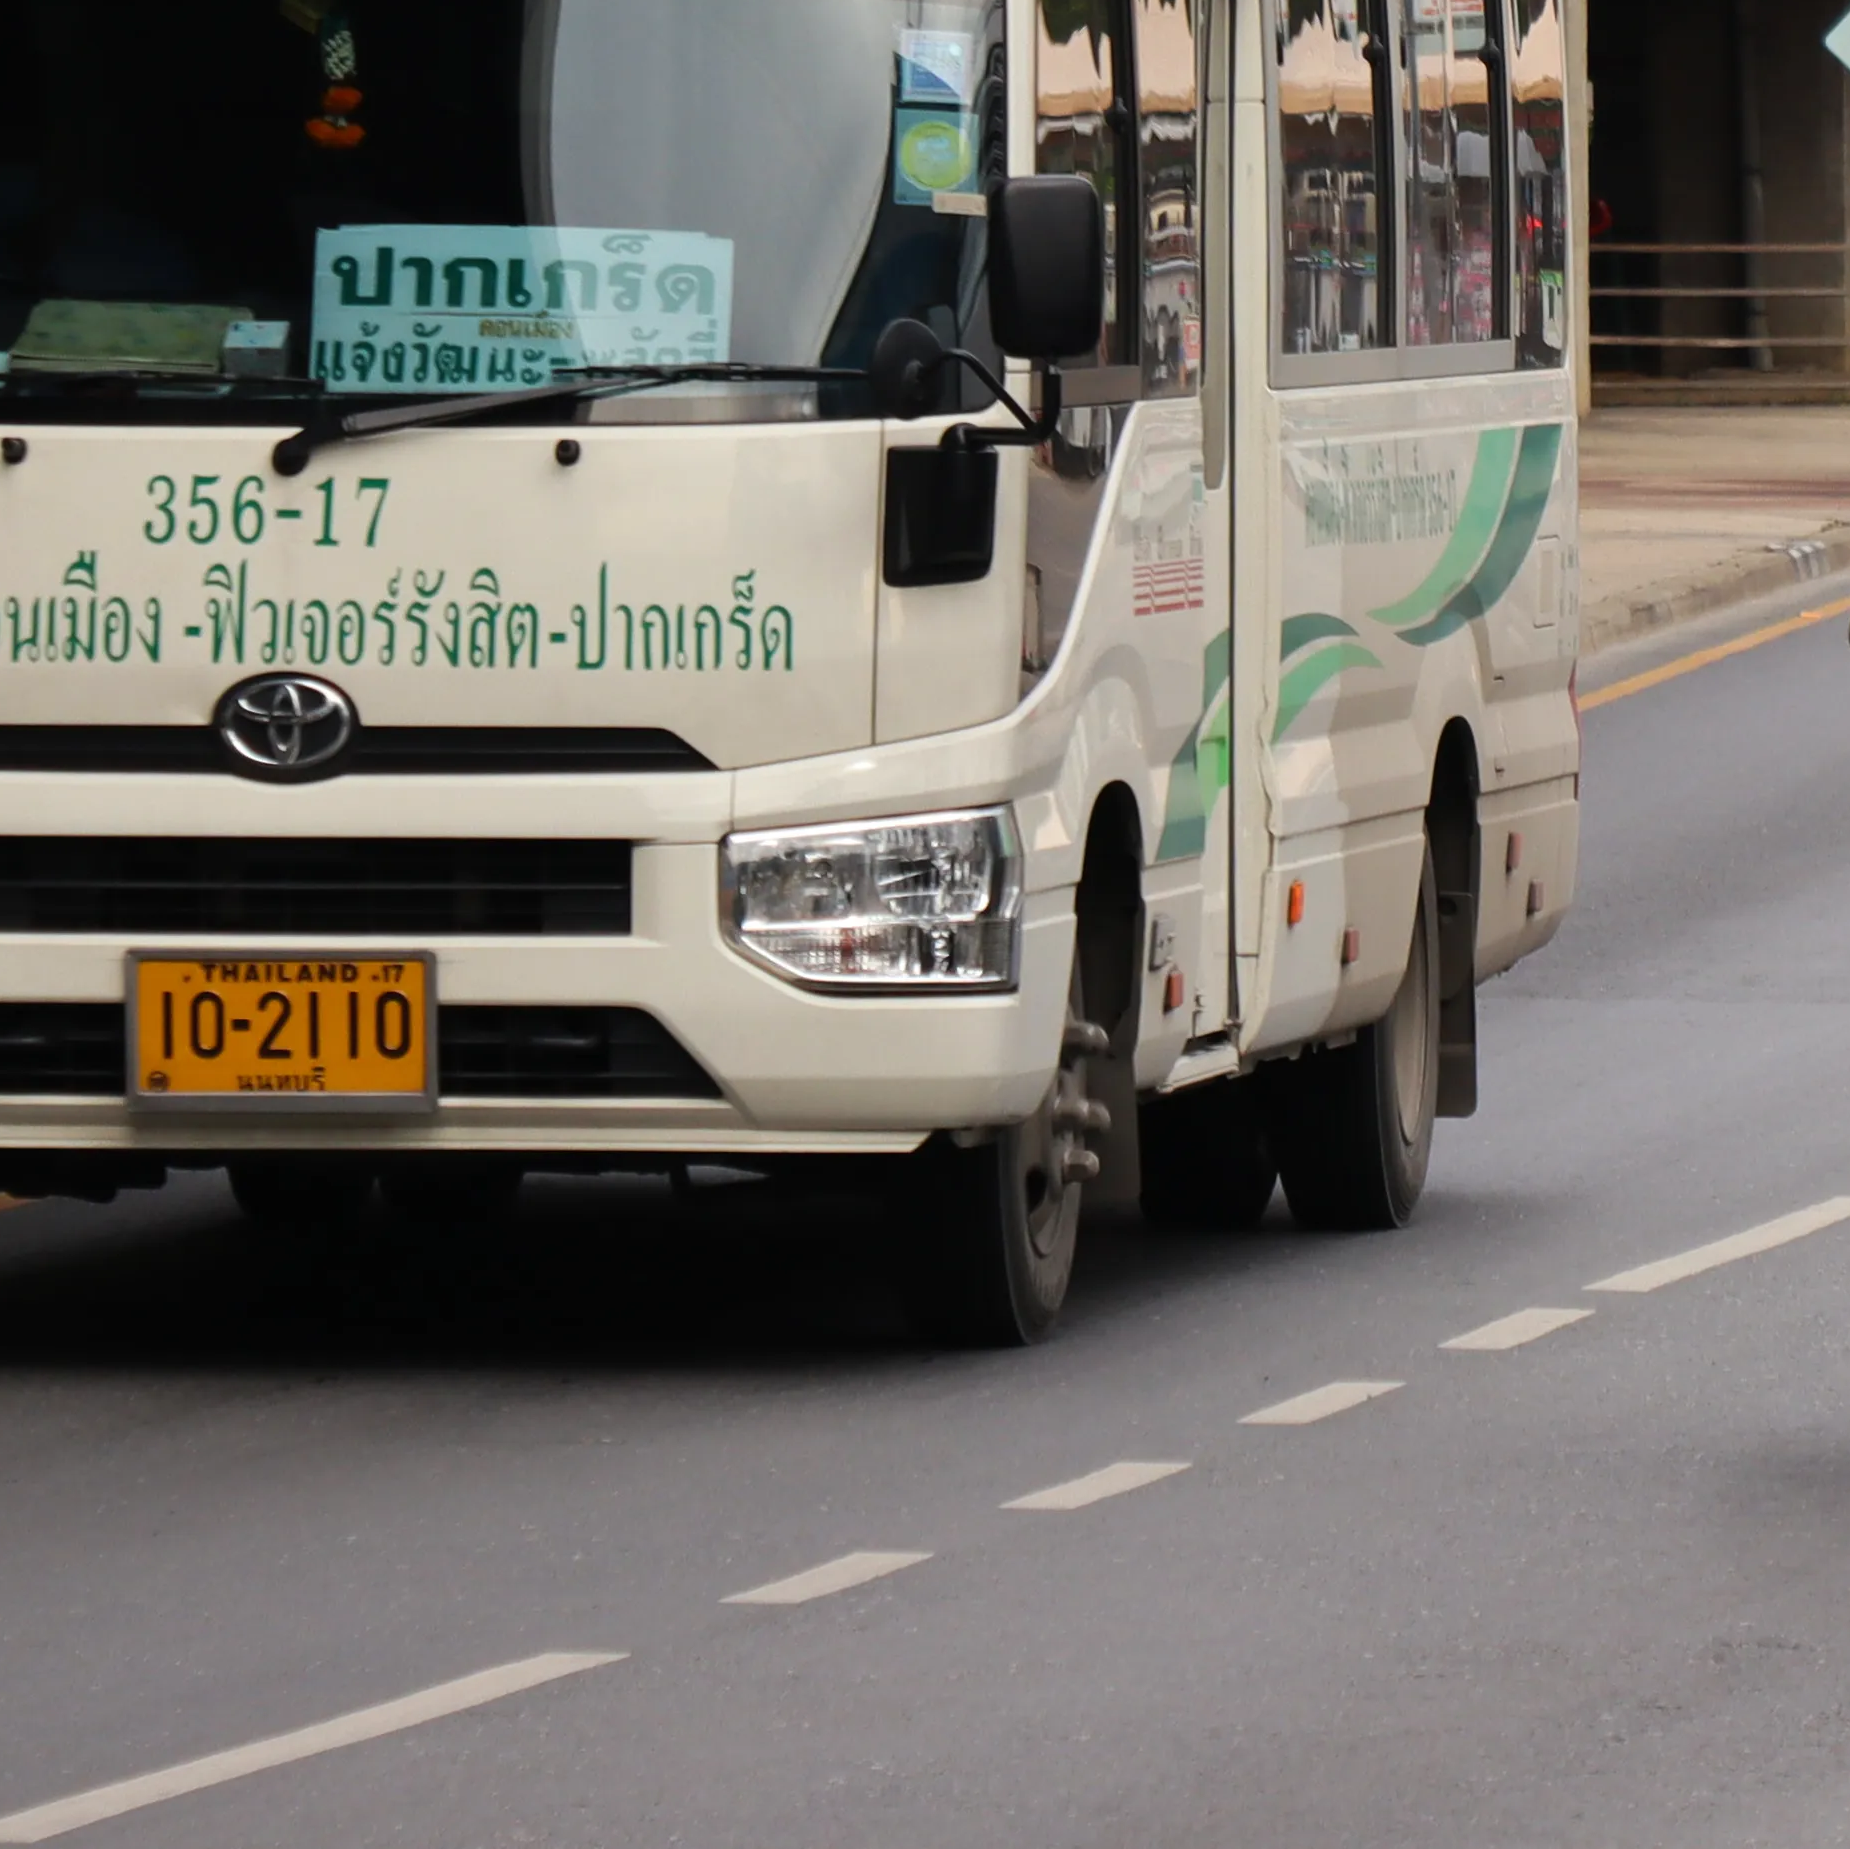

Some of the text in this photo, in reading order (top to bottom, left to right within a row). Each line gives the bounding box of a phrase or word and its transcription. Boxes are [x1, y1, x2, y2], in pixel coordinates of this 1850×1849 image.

[332, 233, 716, 315] ปากเกร็ด
[143, 475, 391, 547] 356-17
[201, 963, 358, 982] THAILAND
[162, 990, 411, 1059] 10-2110
